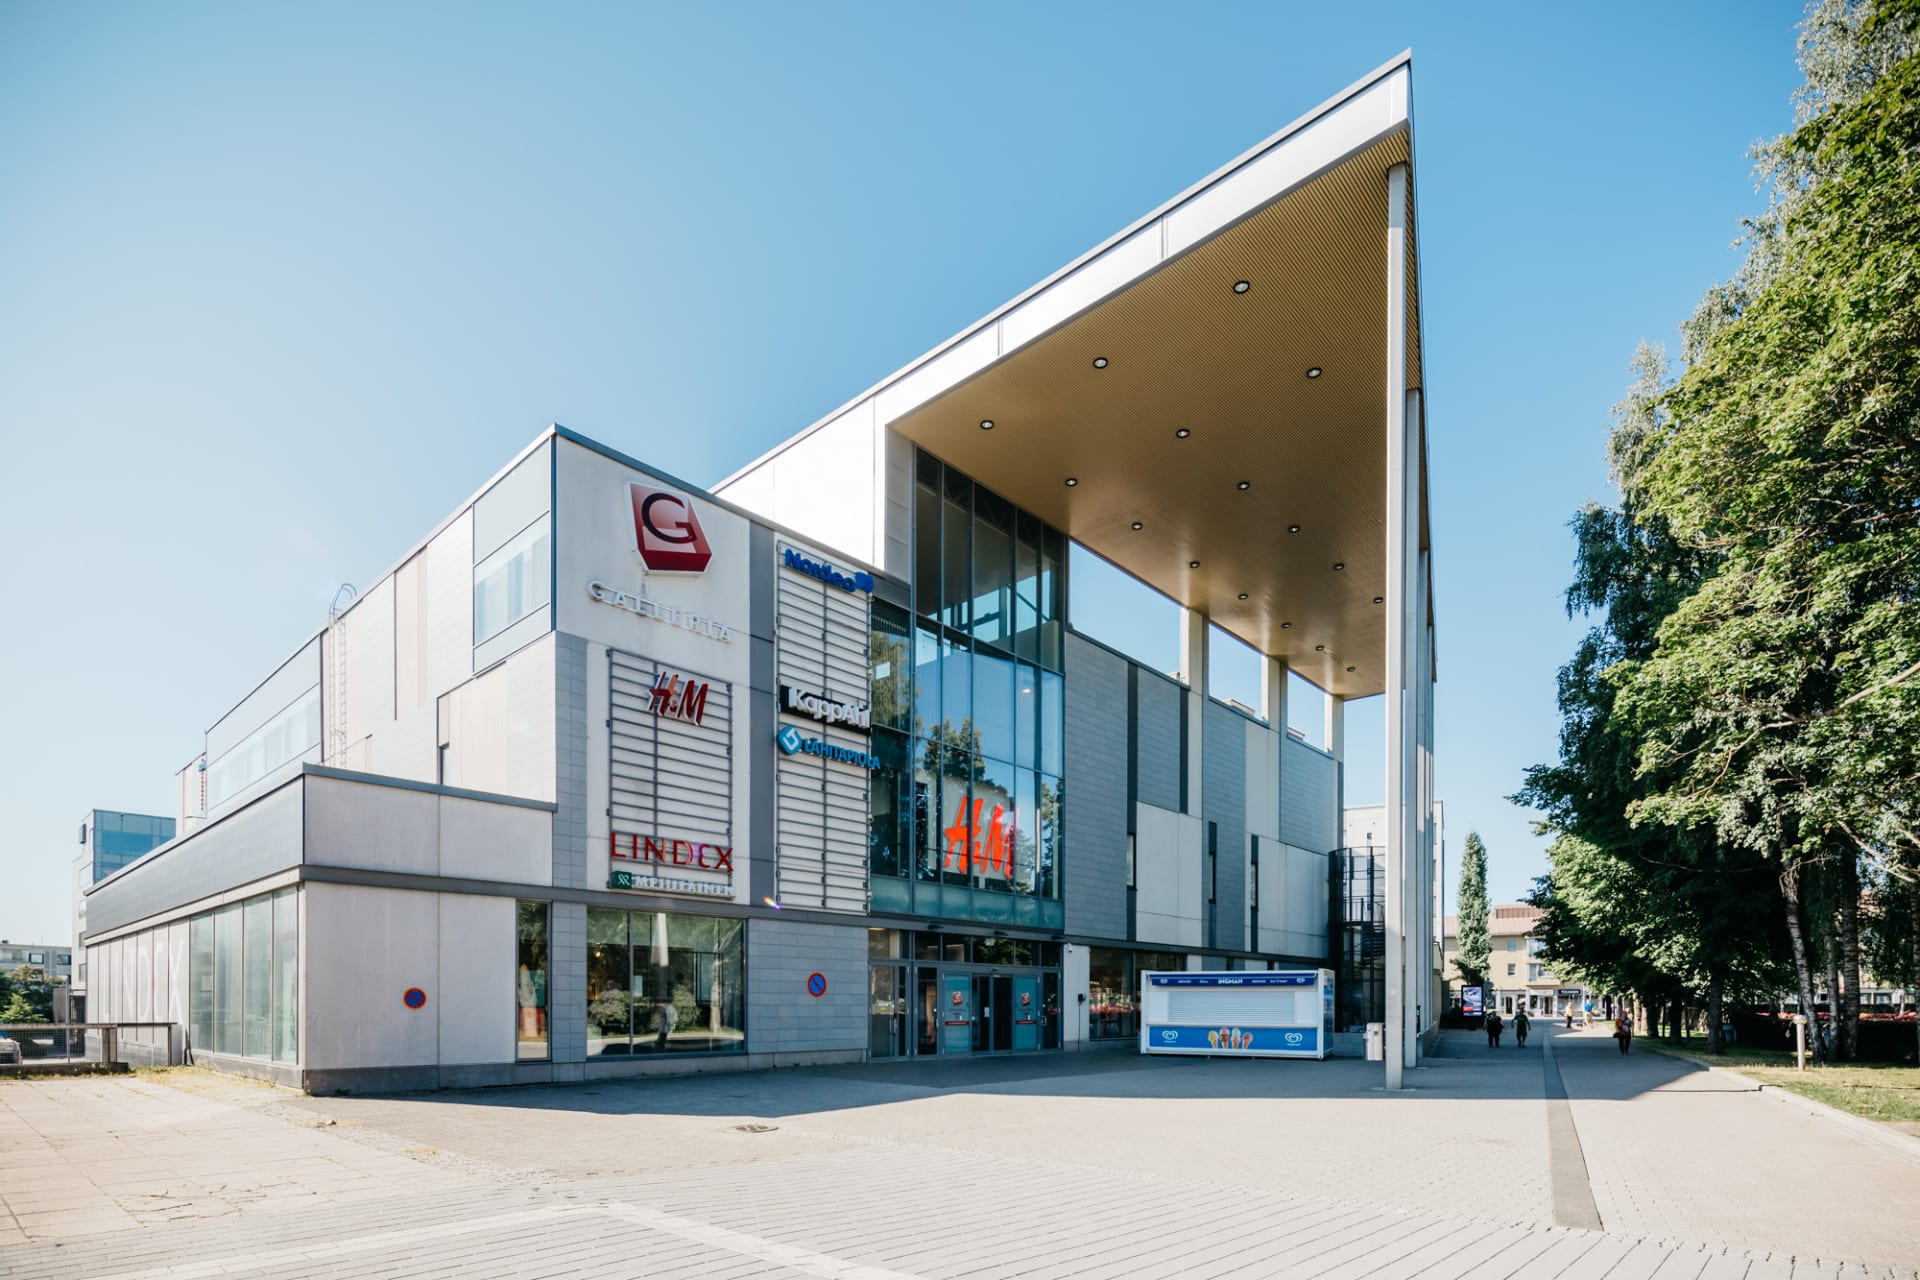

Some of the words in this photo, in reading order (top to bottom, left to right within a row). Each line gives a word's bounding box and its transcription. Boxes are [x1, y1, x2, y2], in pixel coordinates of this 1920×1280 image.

[642, 493, 698, 544] G
[784, 549, 856, 593] Nordea
[648, 671, 708, 727] H&M
[788, 687, 870, 730] KappAhl
[804, 737, 880, 769] LÄHITAPIOLA
[610, 831, 735, 873] LINDEX
[943, 795, 1020, 881] H&M
